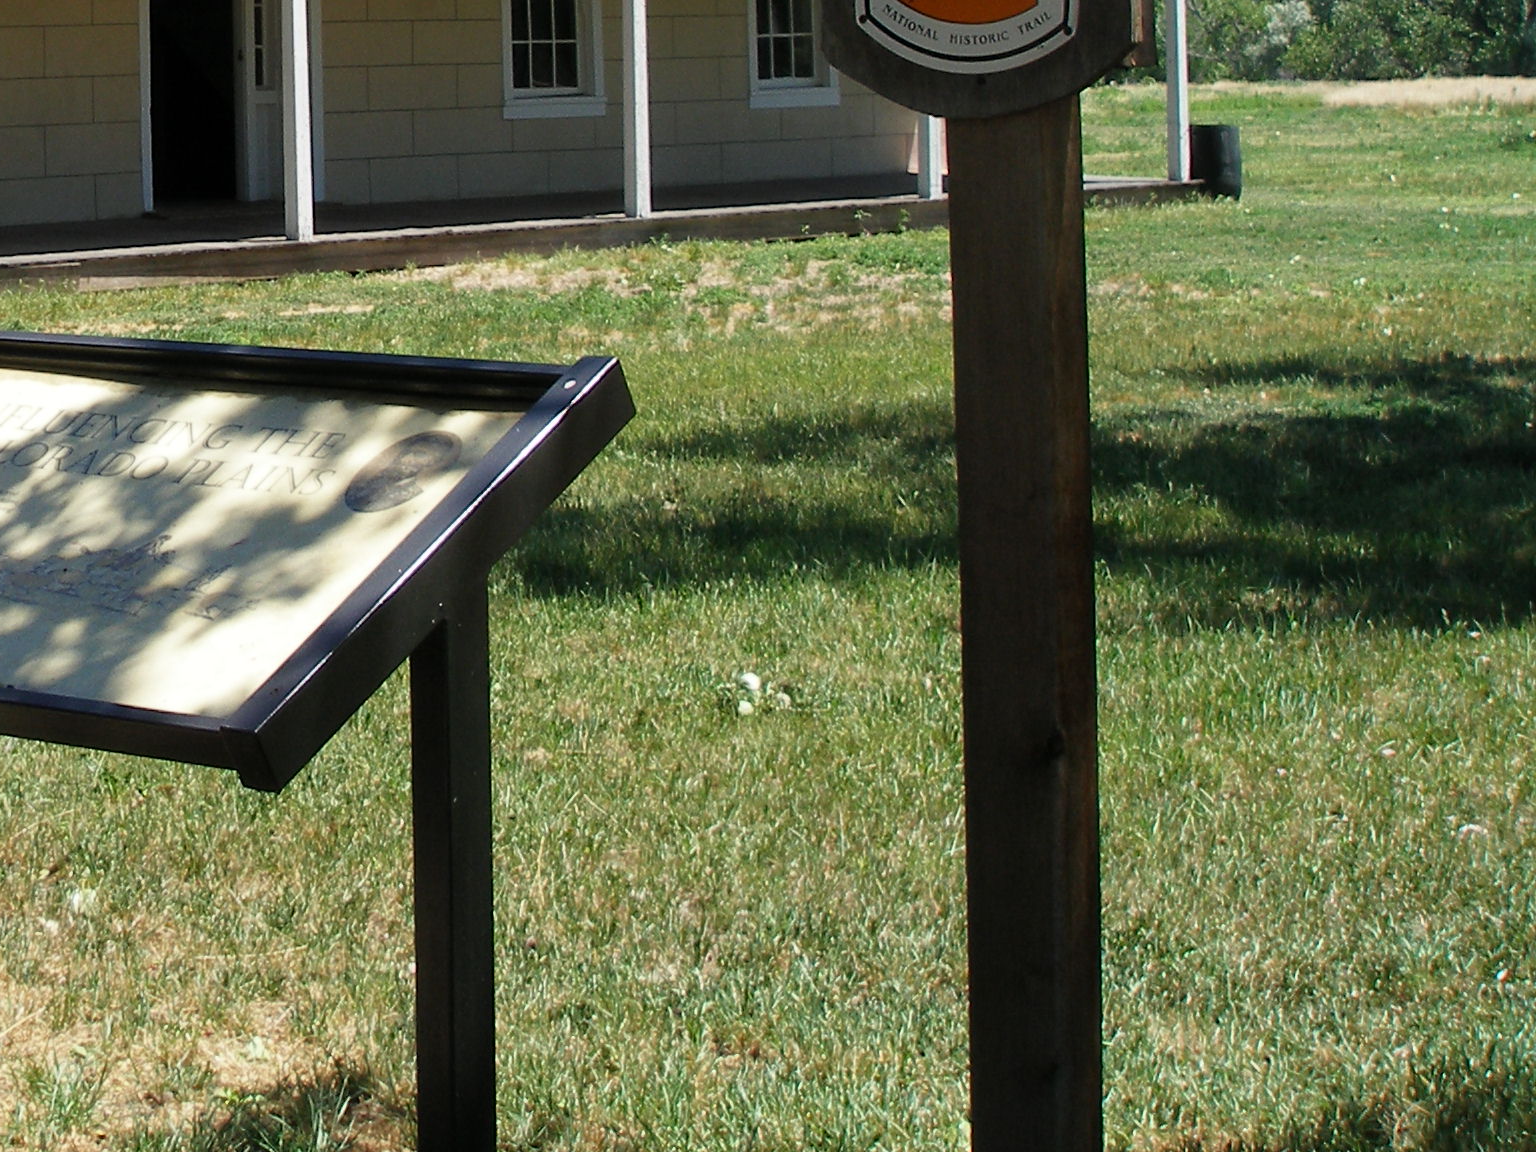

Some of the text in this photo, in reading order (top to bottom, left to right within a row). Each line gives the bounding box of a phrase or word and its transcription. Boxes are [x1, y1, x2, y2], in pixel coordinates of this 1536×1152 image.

[882, 3, 1052, 45] NATIONAL HISTORIC TRAIL
[251, 427, 346, 459] THE
[173, 458, 336, 495] PLAINS
